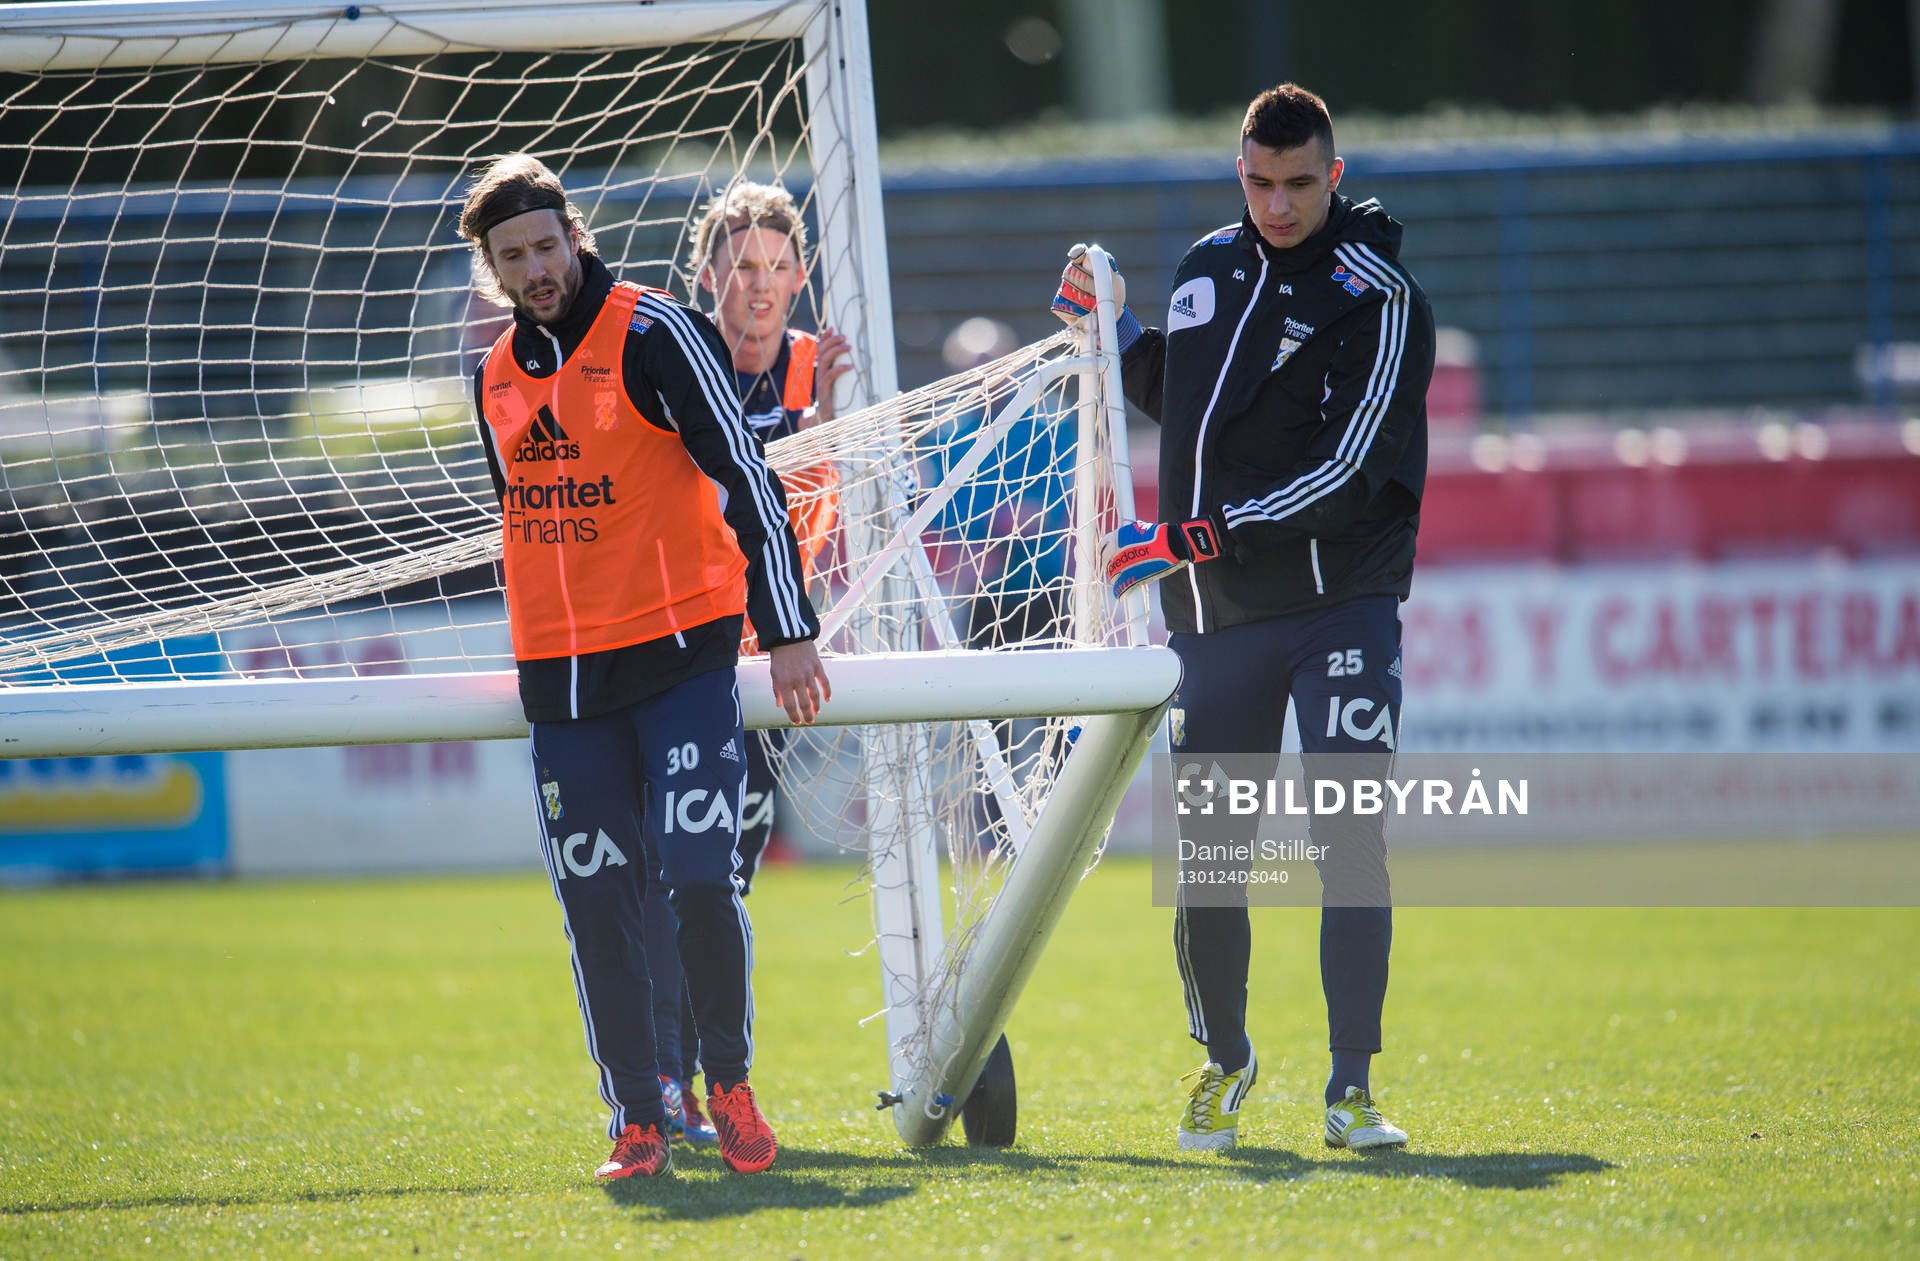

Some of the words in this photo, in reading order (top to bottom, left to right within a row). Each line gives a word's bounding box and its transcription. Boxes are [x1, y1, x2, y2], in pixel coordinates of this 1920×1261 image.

[1232, 269, 1245, 281] ICA
[1279, 284, 1292, 295] ICA
[1172, 304, 1197, 318] adidas
[1284, 317, 1314, 334] Prioritet
[526, 359, 541, 371] ICA
[582, 366, 610, 375] Prioritet
[504, 475, 616, 509] rioritet
[509, 511, 598, 544] Finans
[1109, 548, 1149, 575] predator
[1326, 648, 1365, 677] 25
[1326, 696, 1397, 751] ICA
[667, 742, 699, 776] 30
[720, 751, 739, 762] adidas
[665, 789, 735, 833] ICA
[742, 789, 774, 831] CA
[551, 828, 628, 880] ICA
